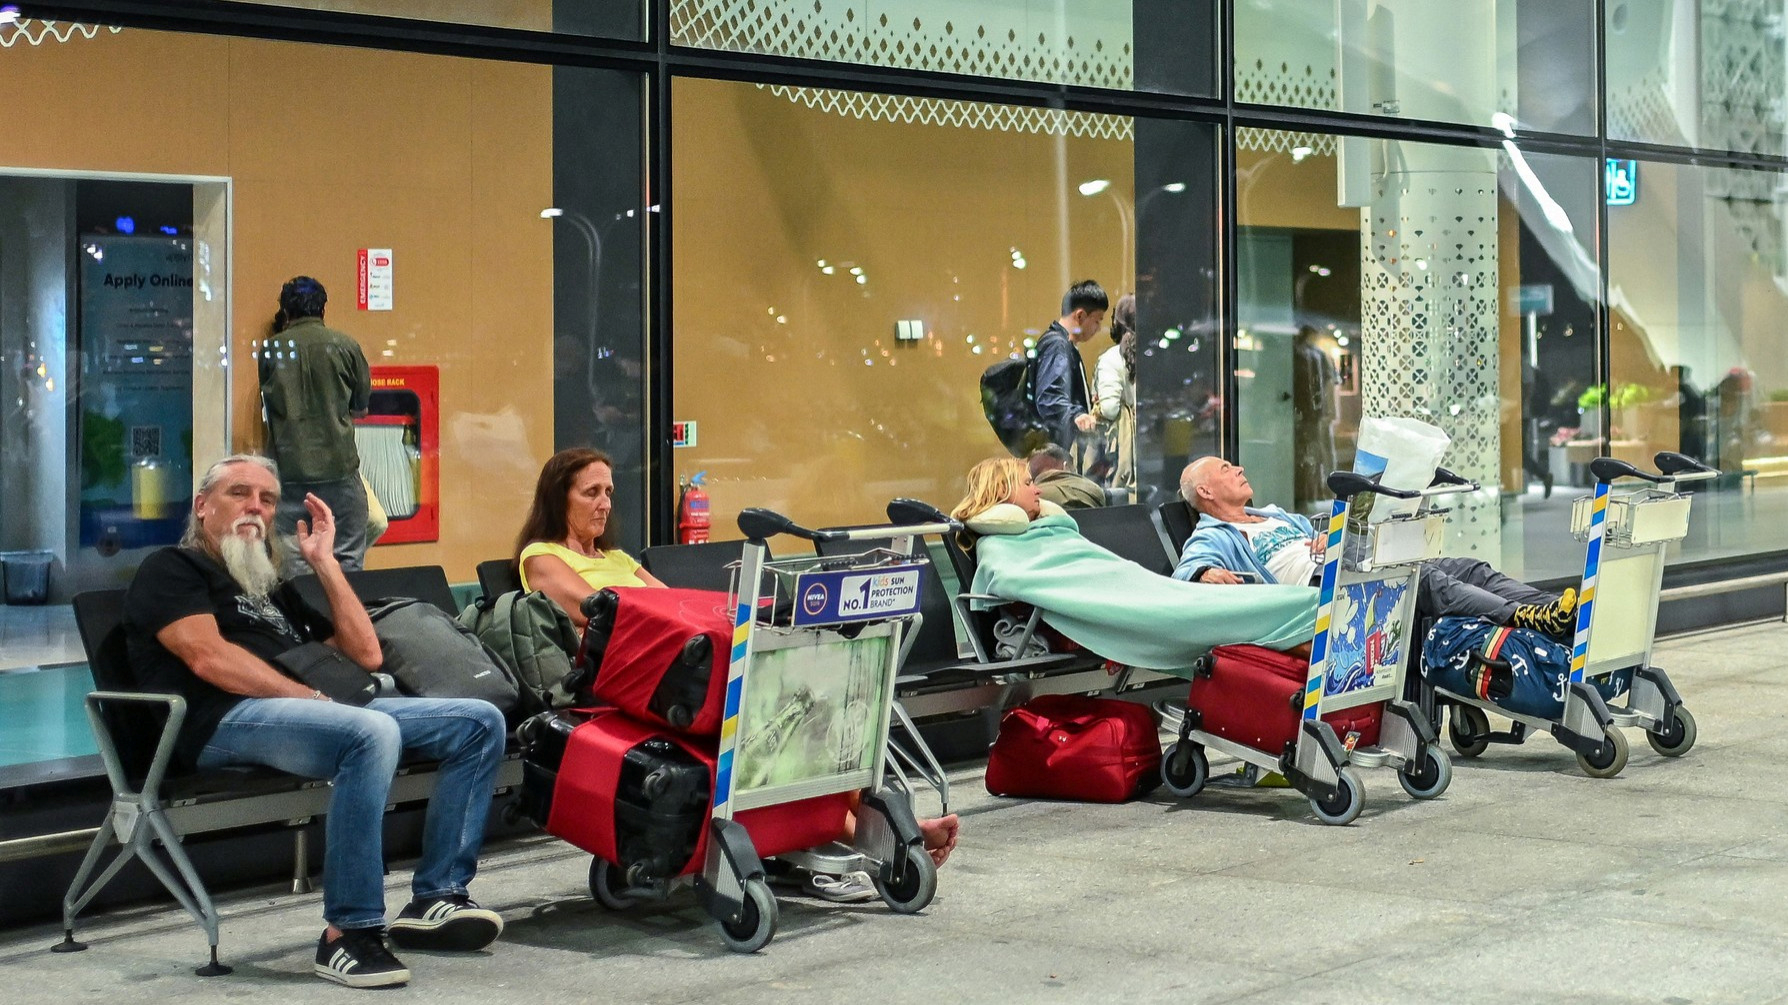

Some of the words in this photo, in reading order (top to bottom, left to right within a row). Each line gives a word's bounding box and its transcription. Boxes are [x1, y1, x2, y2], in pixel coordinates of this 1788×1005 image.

[103, 273, 145, 289] Apply
[371, 378, 386, 386] OSE
[387, 378, 404, 386] RACK
[873, 576, 889, 587] kids
[891, 577, 905, 585] SUN
[807, 593, 825, 601] NIVEA
[871, 586, 914, 598] PROTECTION
